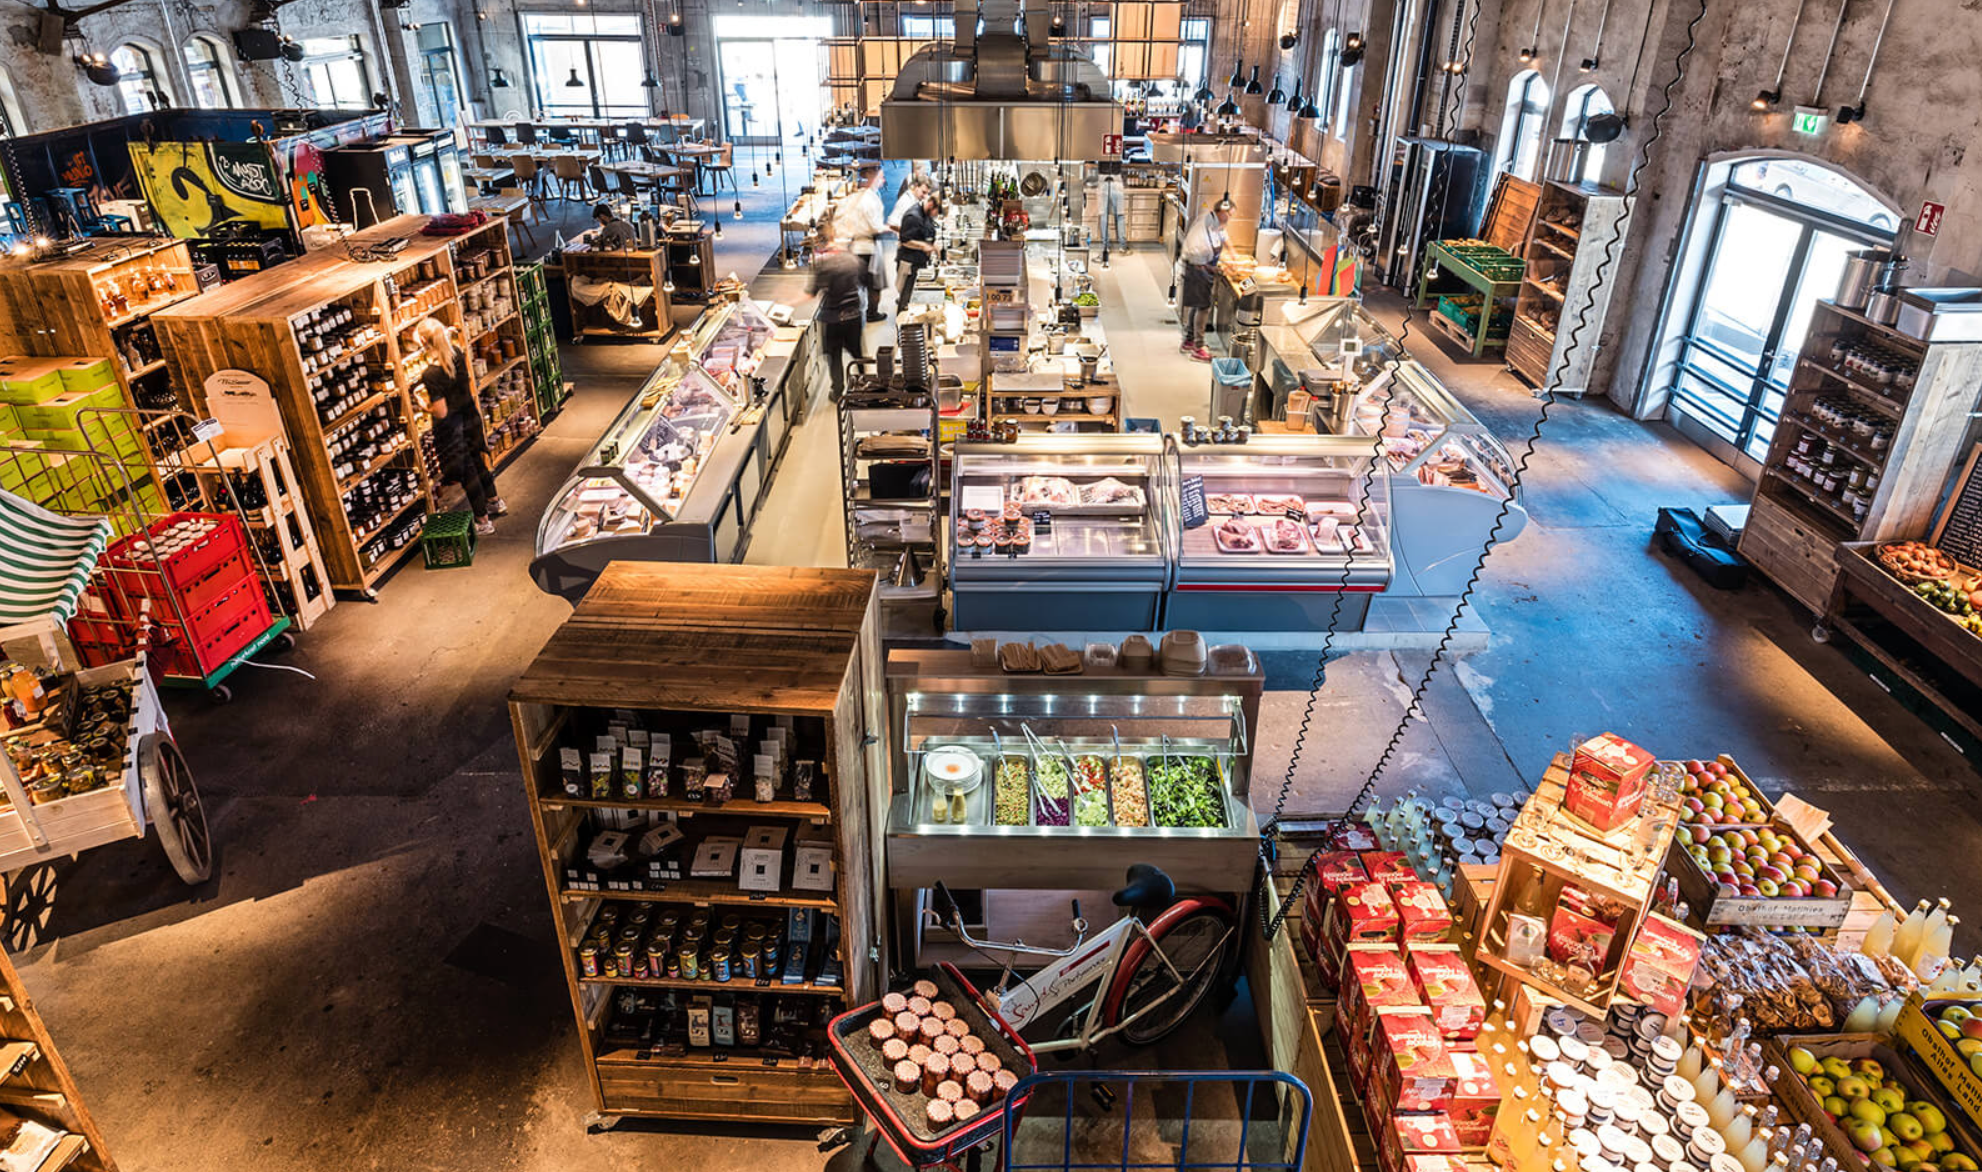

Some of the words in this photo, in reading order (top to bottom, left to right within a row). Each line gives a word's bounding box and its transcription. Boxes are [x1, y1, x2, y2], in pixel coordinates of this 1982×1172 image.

[1921, 1028, 1956, 1068] Obsthof
[1930, 1053, 1953, 1080] Altes
[1957, 1083, 1981, 1113] Land
